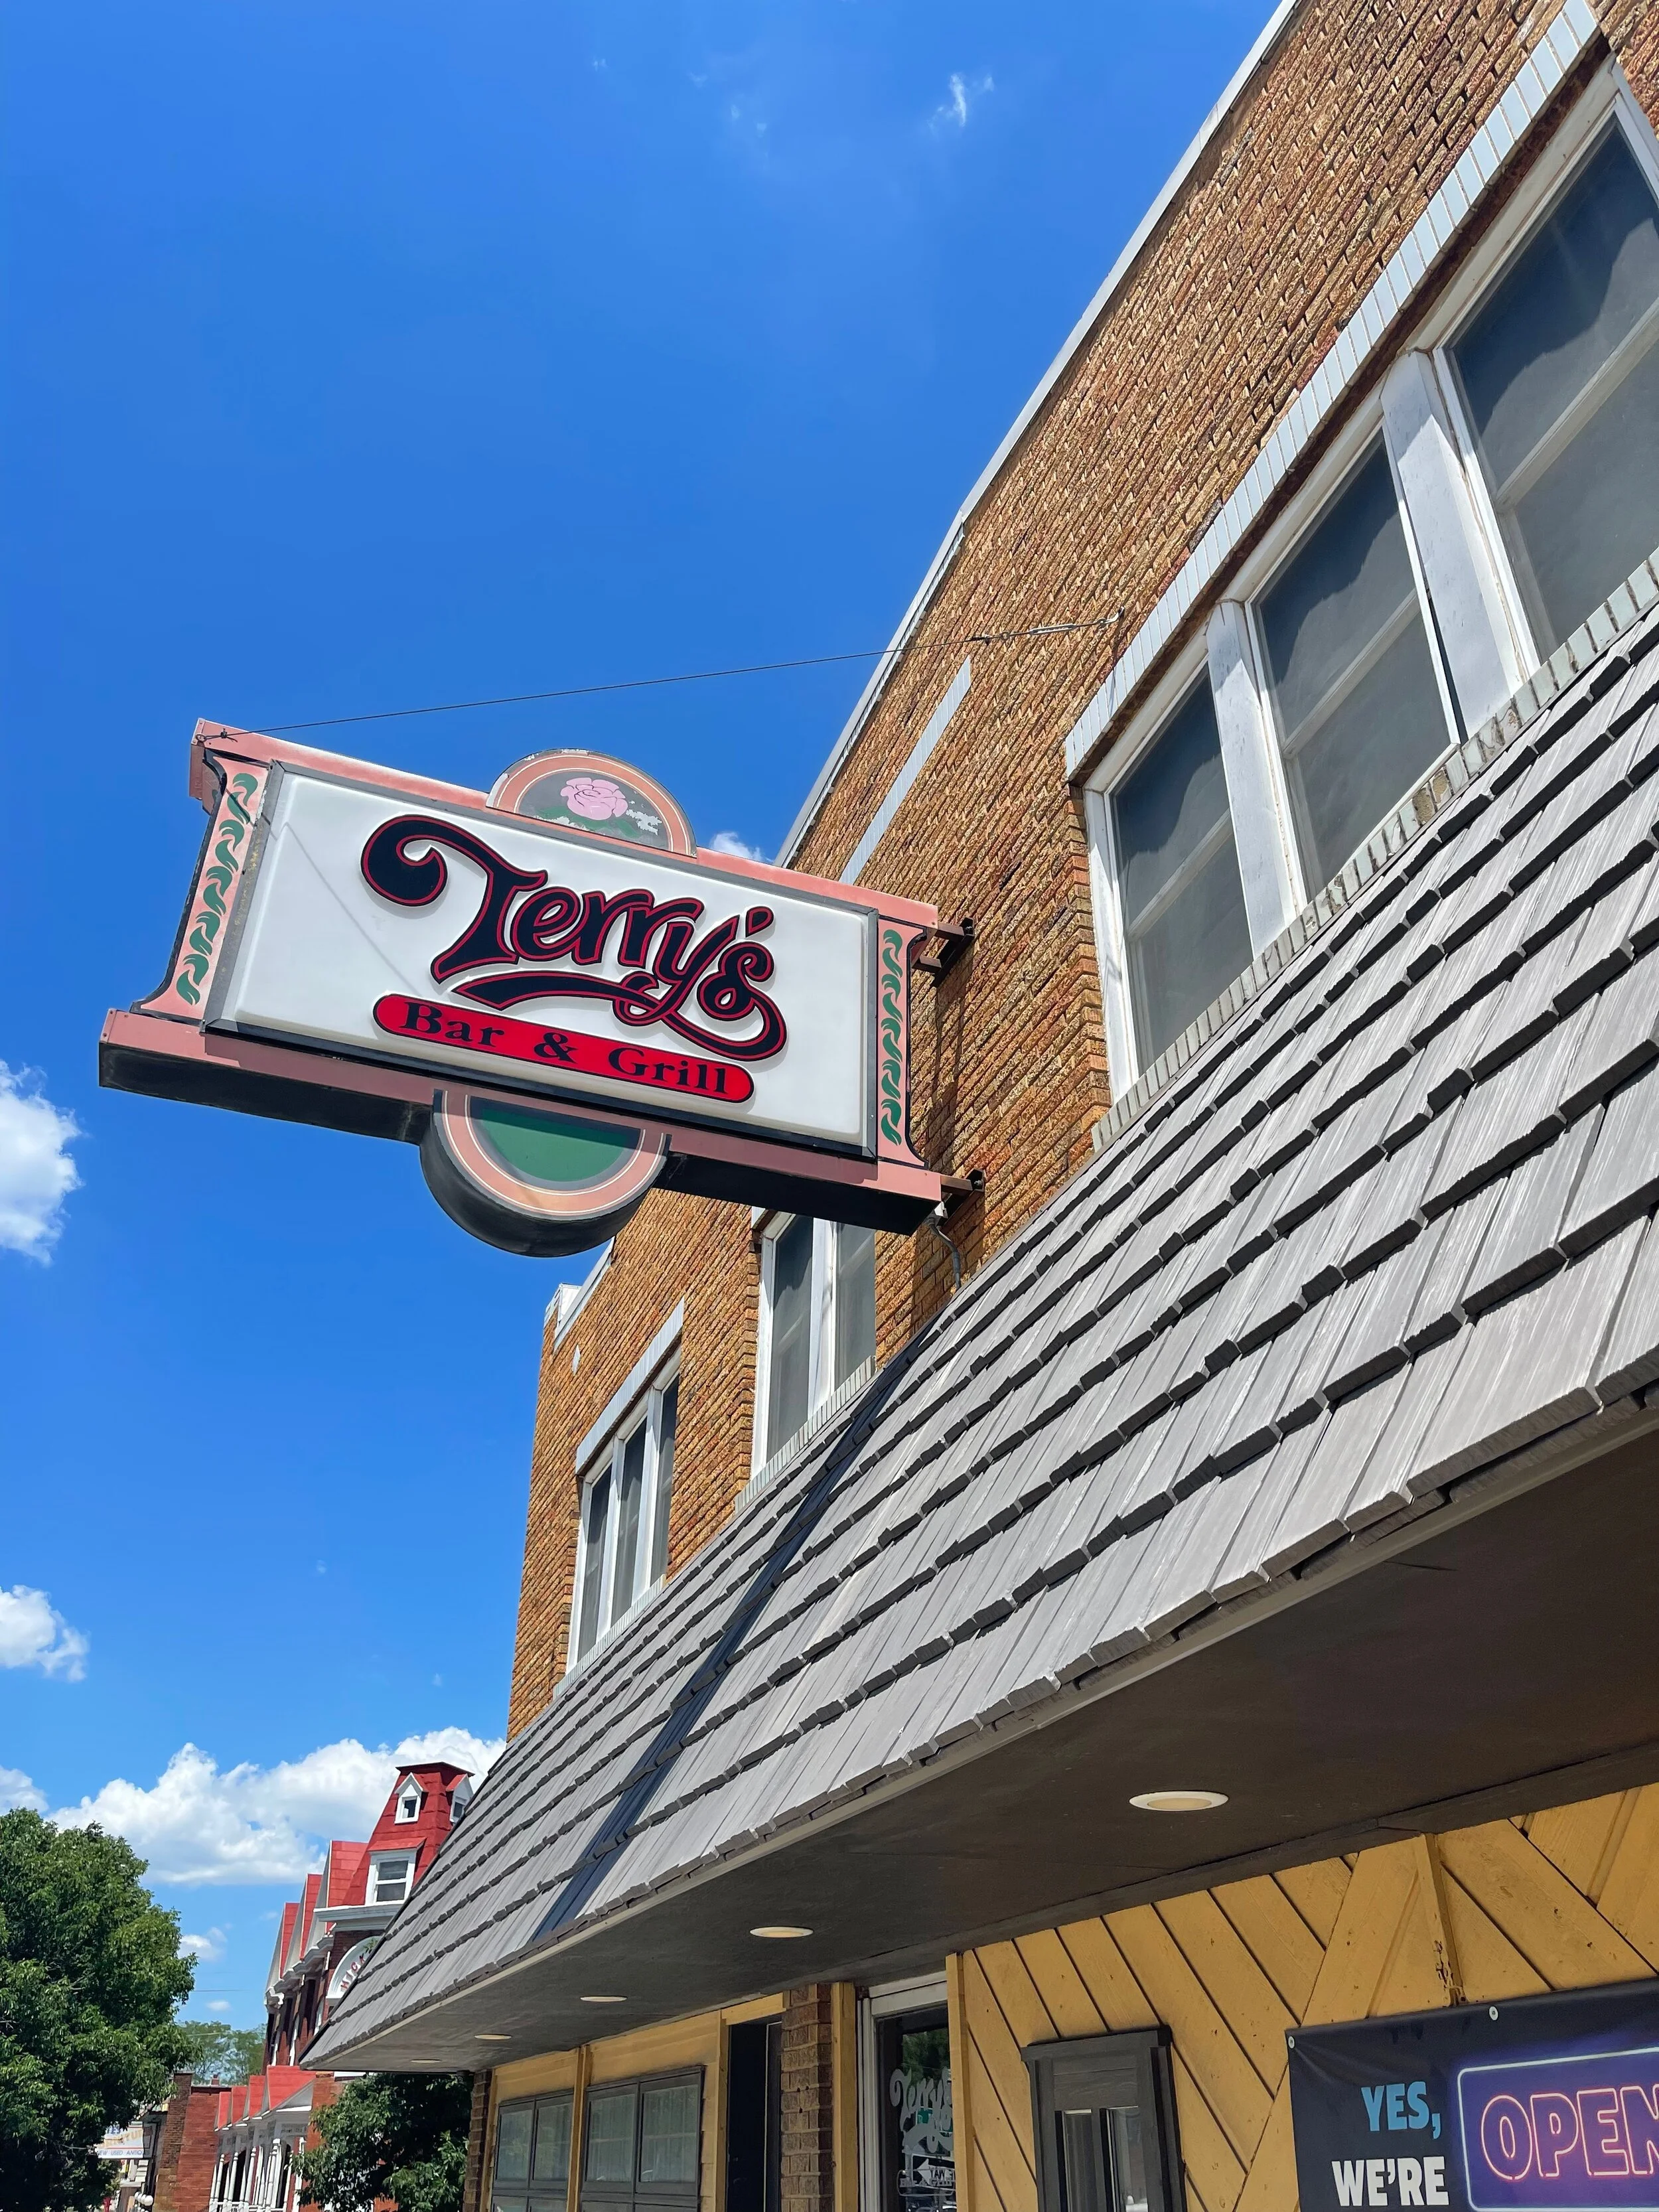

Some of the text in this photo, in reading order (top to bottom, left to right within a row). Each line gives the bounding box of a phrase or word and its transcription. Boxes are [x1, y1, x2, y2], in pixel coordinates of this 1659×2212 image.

[361, 814, 786, 1061] Terry's
[399, 1001, 728, 1095] Bar & Grill
[1361, 2081, 1441, 2139] YES,
[1480, 2083, 1659, 2180] OPEN
[1332, 2156, 1450, 2207] WE'RE
